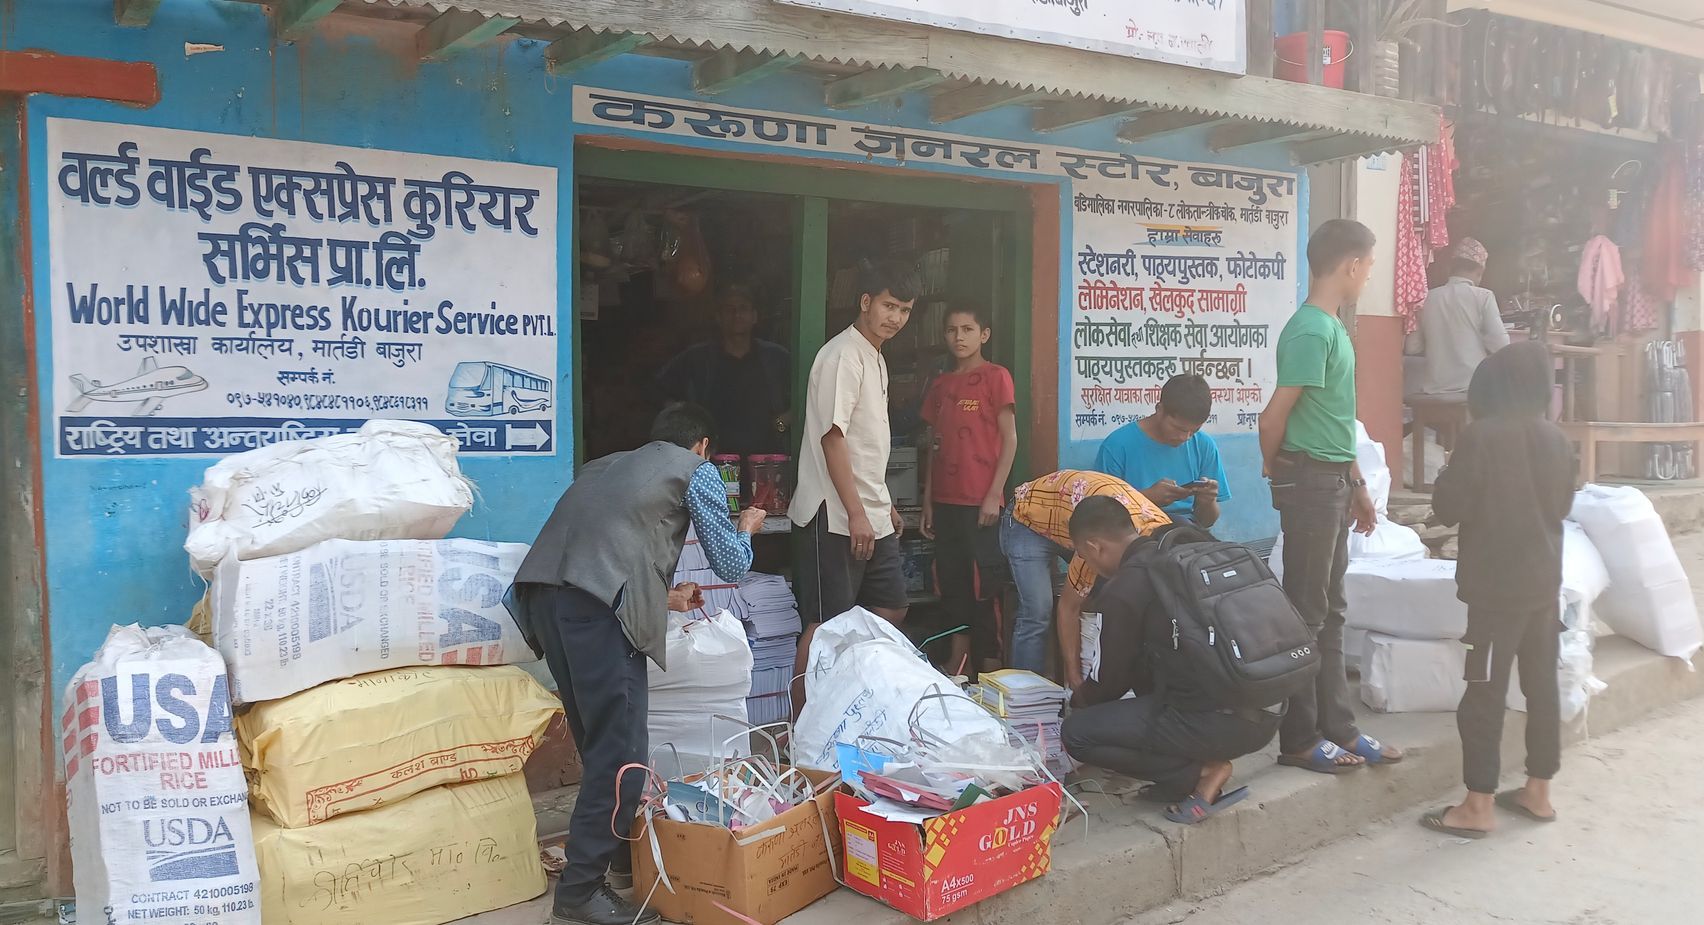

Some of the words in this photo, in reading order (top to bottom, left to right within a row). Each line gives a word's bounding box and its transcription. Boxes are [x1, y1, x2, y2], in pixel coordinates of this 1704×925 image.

[851, 127, 1040, 169] जनरल
[1056, 150, 1179, 191] स्टोर,
[1187, 166, 1297, 206] बाजुरा
[58, 141, 141, 206] वर्ल्ड
[147, 147, 243, 221] वाईड
[248, 161, 396, 226] एक्सप्रेस
[403, 171, 540, 240] कुरियर
[1147, 228, 1180, 247] हाम्रा
[198, 222, 323, 287] सर्भिस
[1225, 251, 1287, 281] फोटोकपी
[66, 282, 149, 326] World
[159, 286, 228, 328] Wide
[237, 289, 331, 337] Express
[341, 296, 434, 334] Kourier
[435, 300, 518, 336] Service
[1148, 281, 1196, 318] खेलकुद
[1197, 283, 1247, 316] सामाग्री
[1144, 318, 1181, 350] शिक्षक
[1184, 318, 1208, 348] सेवा
[1210, 318, 1268, 348] आयोगका
[312, 334, 366, 361] मार्तडी
[376, 341, 423, 368] बाजुरा
[277, 367, 319, 386] सम्पर्क
[1075, 409, 1097, 427] सम्पर्क
[65, 420, 145, 454] राष्ट्रिय
[147, 427, 197, 449] तथा
[199, 749, 241, 770] MILL
[390, 759, 426, 780] कलश
[160, 771, 208, 790] RICE
[101, 801, 121, 815] NOT
[125, 800, 140, 811] TO
[143, 800, 157, 810] BE
[161, 798, 189, 809] SOLD
[192, 797, 208, 808] OR
[210, 791, 249, 807] EXCHAN
[1004, 802, 1037, 824] JNS
[143, 815, 234, 847] USDA
[979, 820, 1036, 851] GOLD
[132, 890, 189, 904] CONTRACT
[941, 895, 951, 904] 75
[952, 889, 968, 903] gsm
[128, 909, 147, 919] NET
[194, 904, 204, 915] 50
